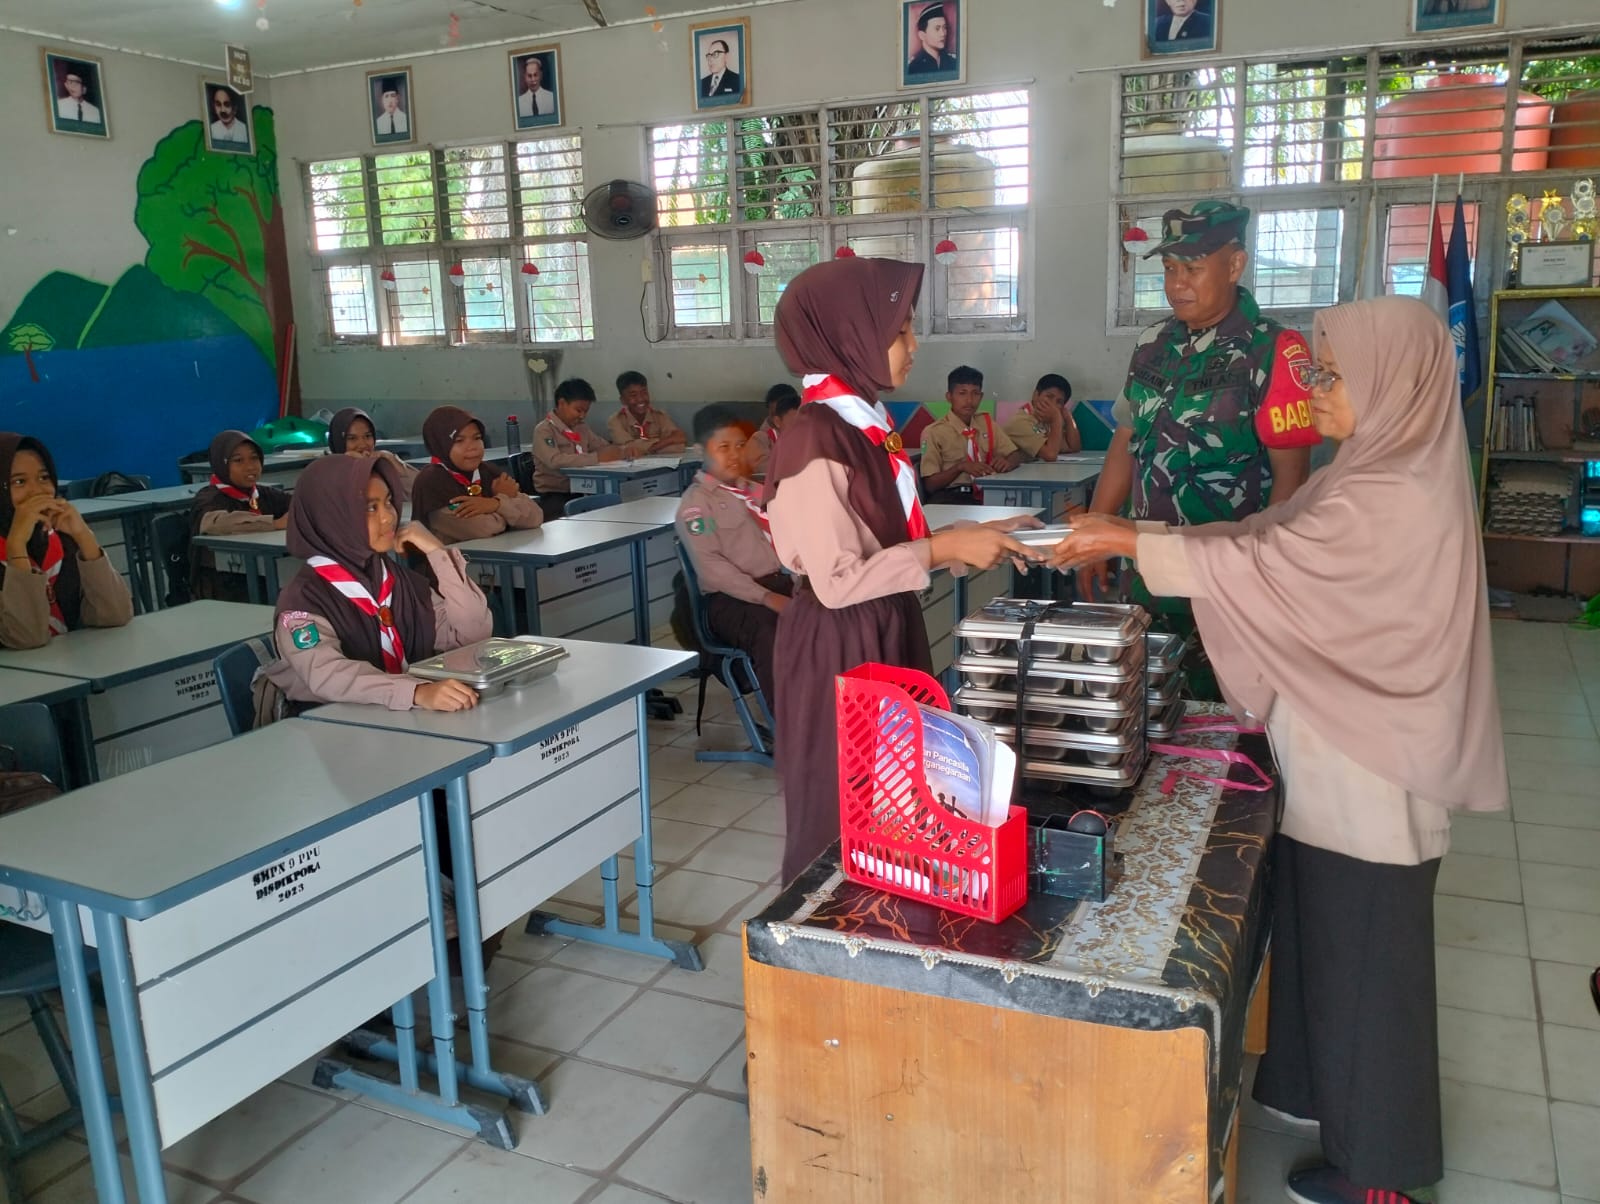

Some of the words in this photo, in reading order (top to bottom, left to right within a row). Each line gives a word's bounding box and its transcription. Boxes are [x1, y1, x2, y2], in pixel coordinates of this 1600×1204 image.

[176, 679, 216, 697] DISDIKPOR
[540, 733, 559, 749] SMPN
[554, 751, 570, 764] 2023
[933, 751, 970, 774] Pancasila
[252, 861, 286, 887] SMPN
[288, 857, 296, 869] 9
[298, 845, 321, 865] PPU
[256, 861, 321, 900] DISDIKPORA
[278, 882, 305, 903] 2023
